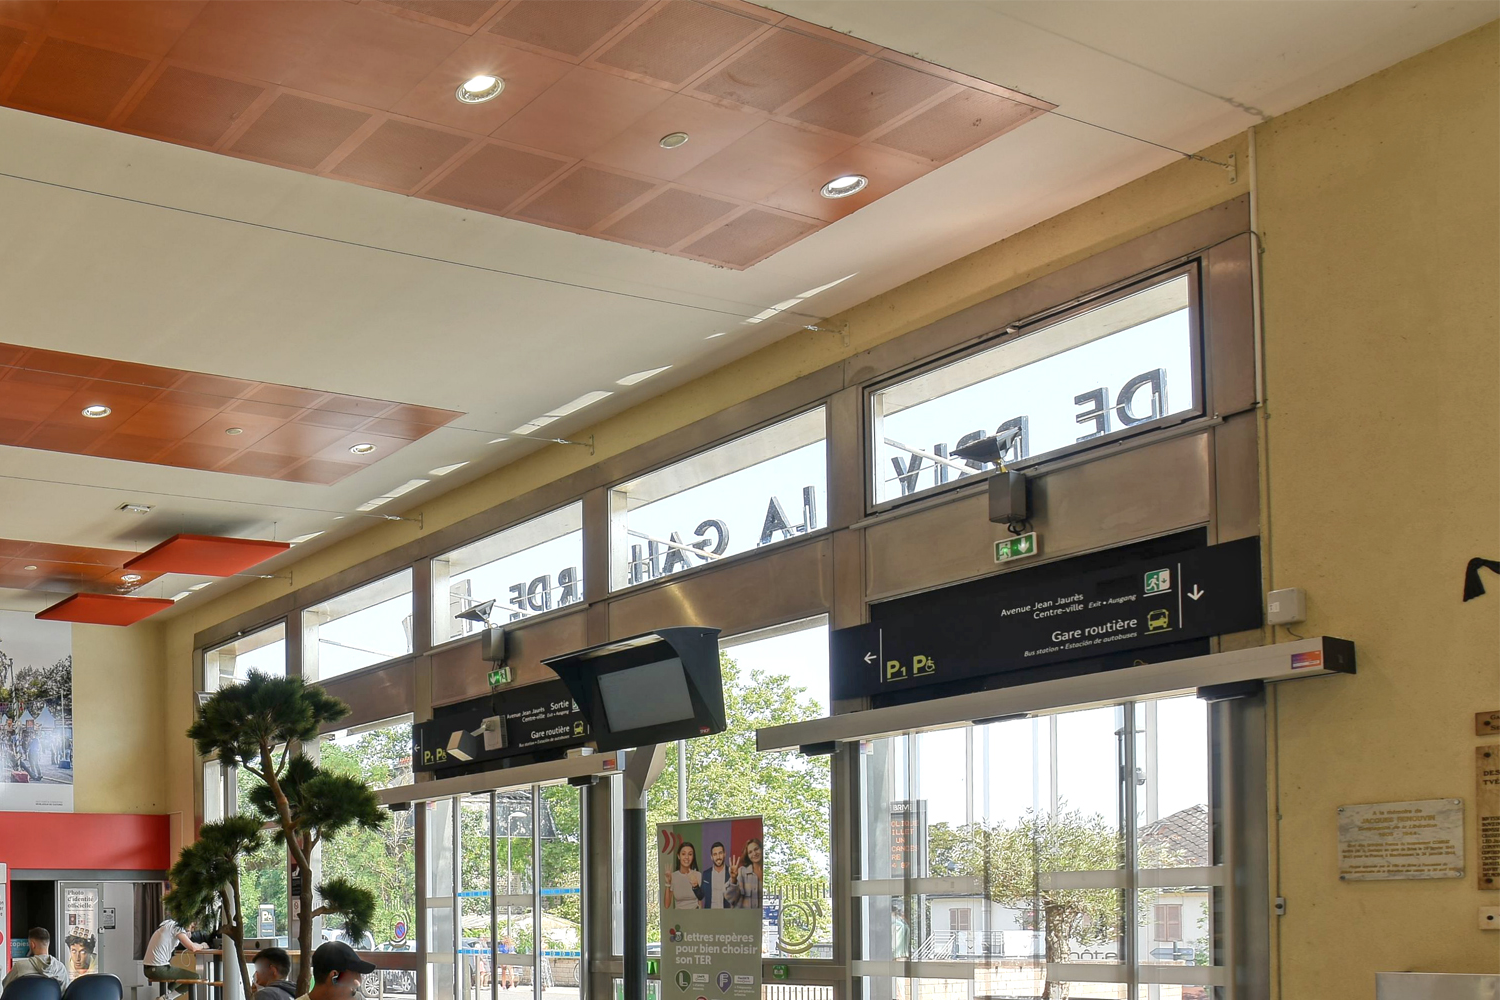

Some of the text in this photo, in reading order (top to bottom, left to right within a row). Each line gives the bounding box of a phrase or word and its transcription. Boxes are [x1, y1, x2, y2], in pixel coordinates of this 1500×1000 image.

[1000, 593, 1084, 617] Avenue Jean Jaurès
[1088, 594, 1137, 609] Exit Ausgang
[1033, 603, 1084, 619] Centre-ville
[1052, 618, 1138, 642] Gare routière
[1036, 645, 1059, 655] station
[1064, 639, 1093, 650] Estación
[1103, 631, 1138, 643] autobuses
[550, 700, 569, 711] Sortie
[506, 706, 545, 720] Avenue Jean Jaurès
[521, 713, 545, 723] Centre-ville
[531, 724, 570, 739] Gare routière
[684, 932, 713, 942] lettres
[716, 932, 754, 944] repères
[676, 944, 758, 954] pour bien choisir
[694, 955, 712, 965] TER
